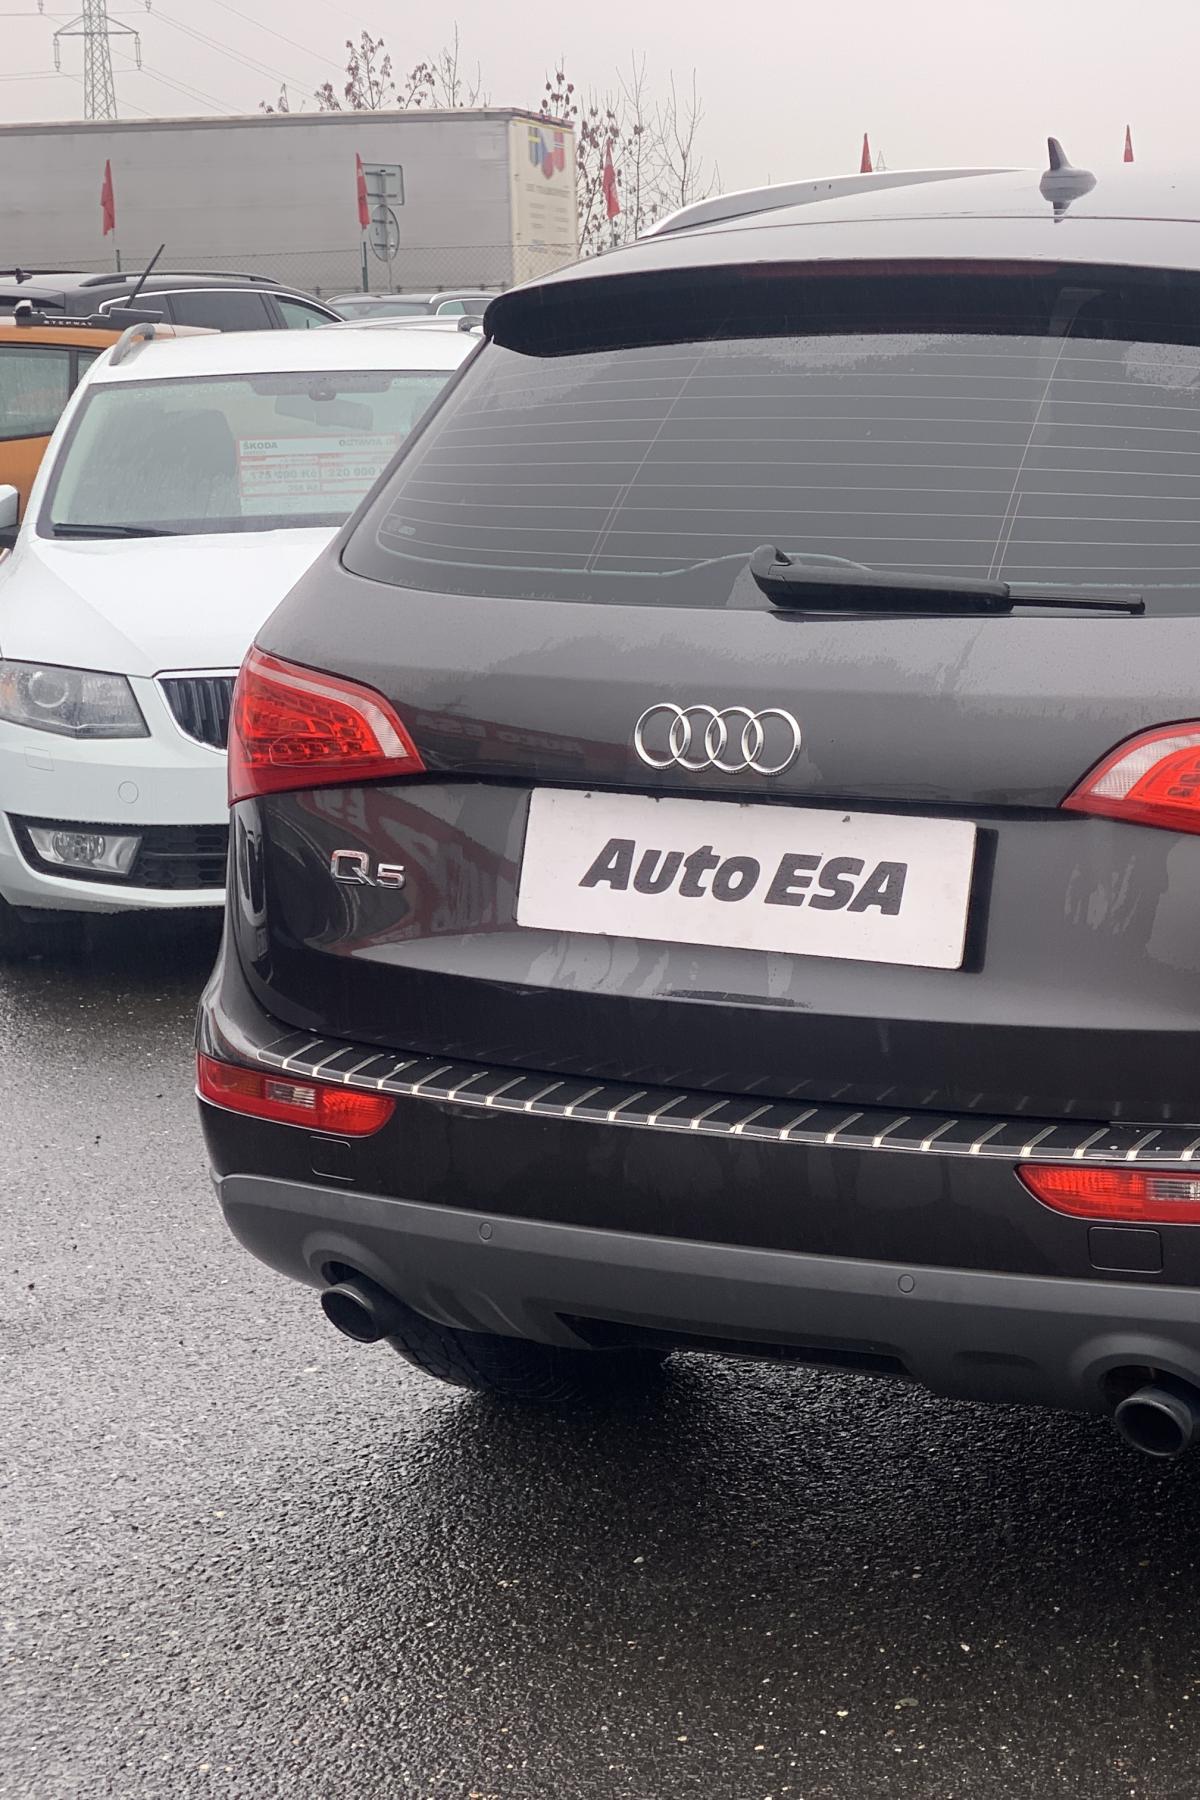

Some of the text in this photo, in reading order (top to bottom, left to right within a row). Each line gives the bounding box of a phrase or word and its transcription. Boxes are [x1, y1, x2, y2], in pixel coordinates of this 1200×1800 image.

[331, 849, 406, 889] Q5
[578, 838, 908, 916] Auto ESA
